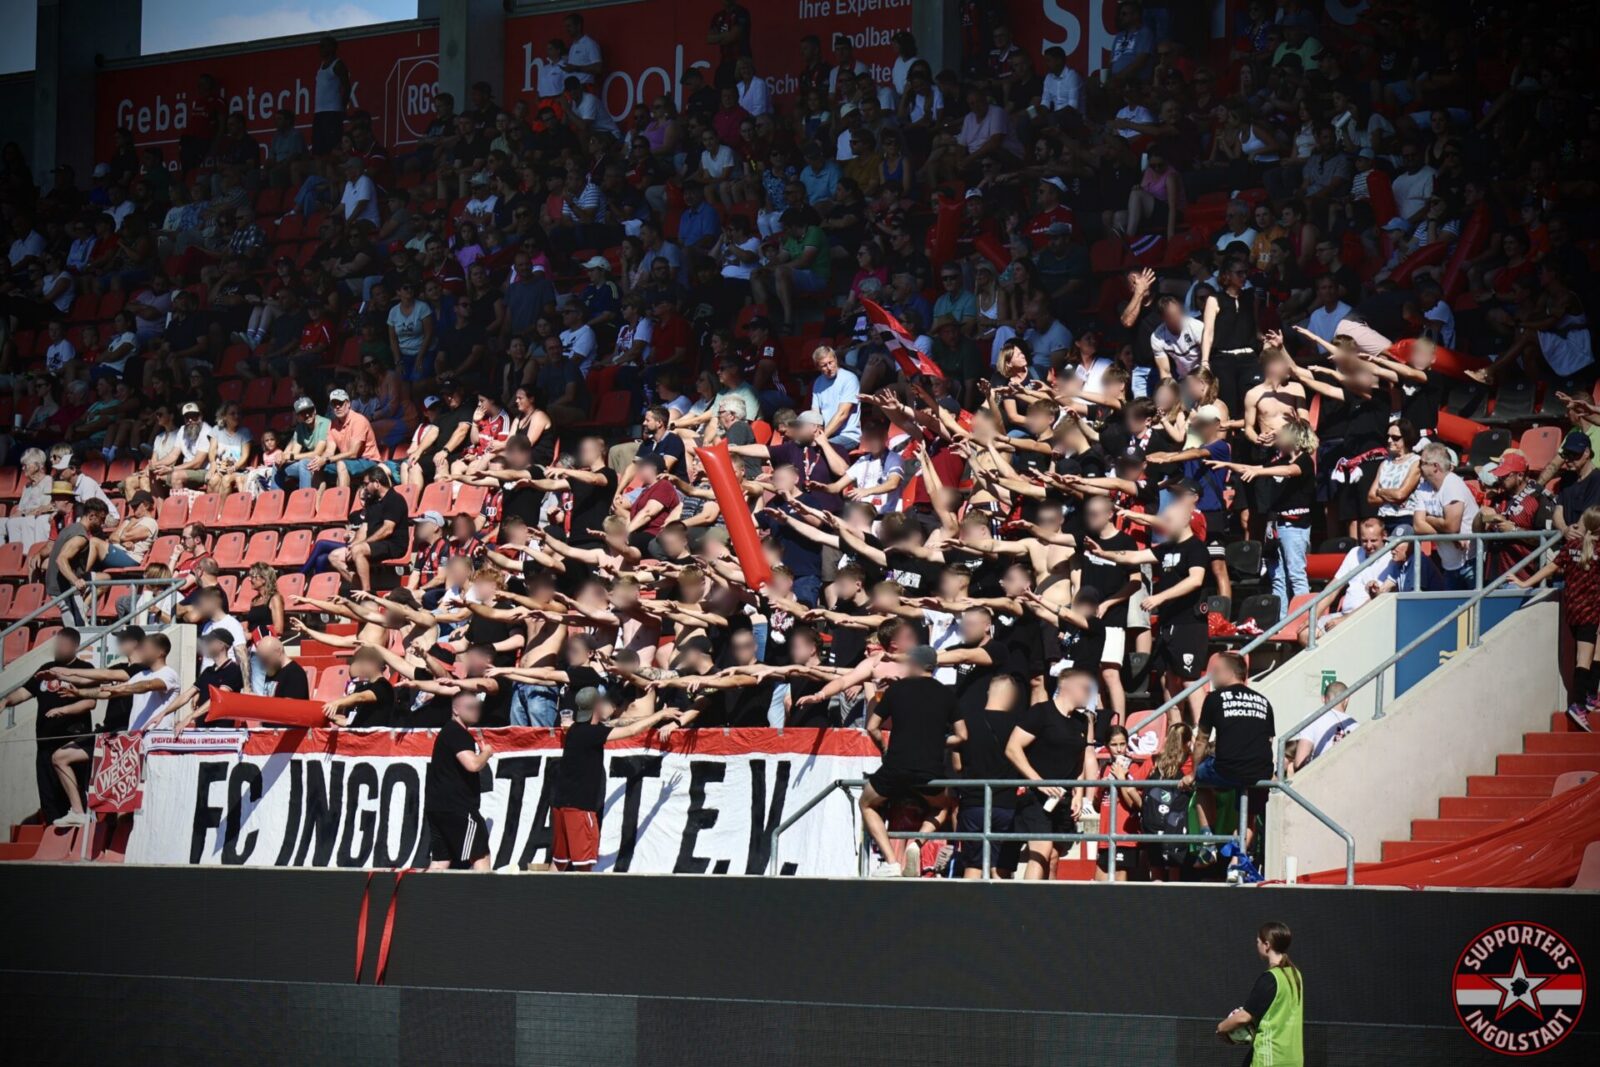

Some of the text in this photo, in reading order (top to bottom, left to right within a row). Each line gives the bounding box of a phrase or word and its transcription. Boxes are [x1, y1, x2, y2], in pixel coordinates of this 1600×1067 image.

[799, 0, 831, 19] Ihre
[1220, 691, 1268, 707] 15 JAHRE
[1222, 701, 1268, 713] SUPPORTERS
[1223, 709, 1267, 720] INGOLSTADT
[98, 746, 139, 793] WEHEN
[190, 755, 799, 875] FC INGOTAT E.V.
